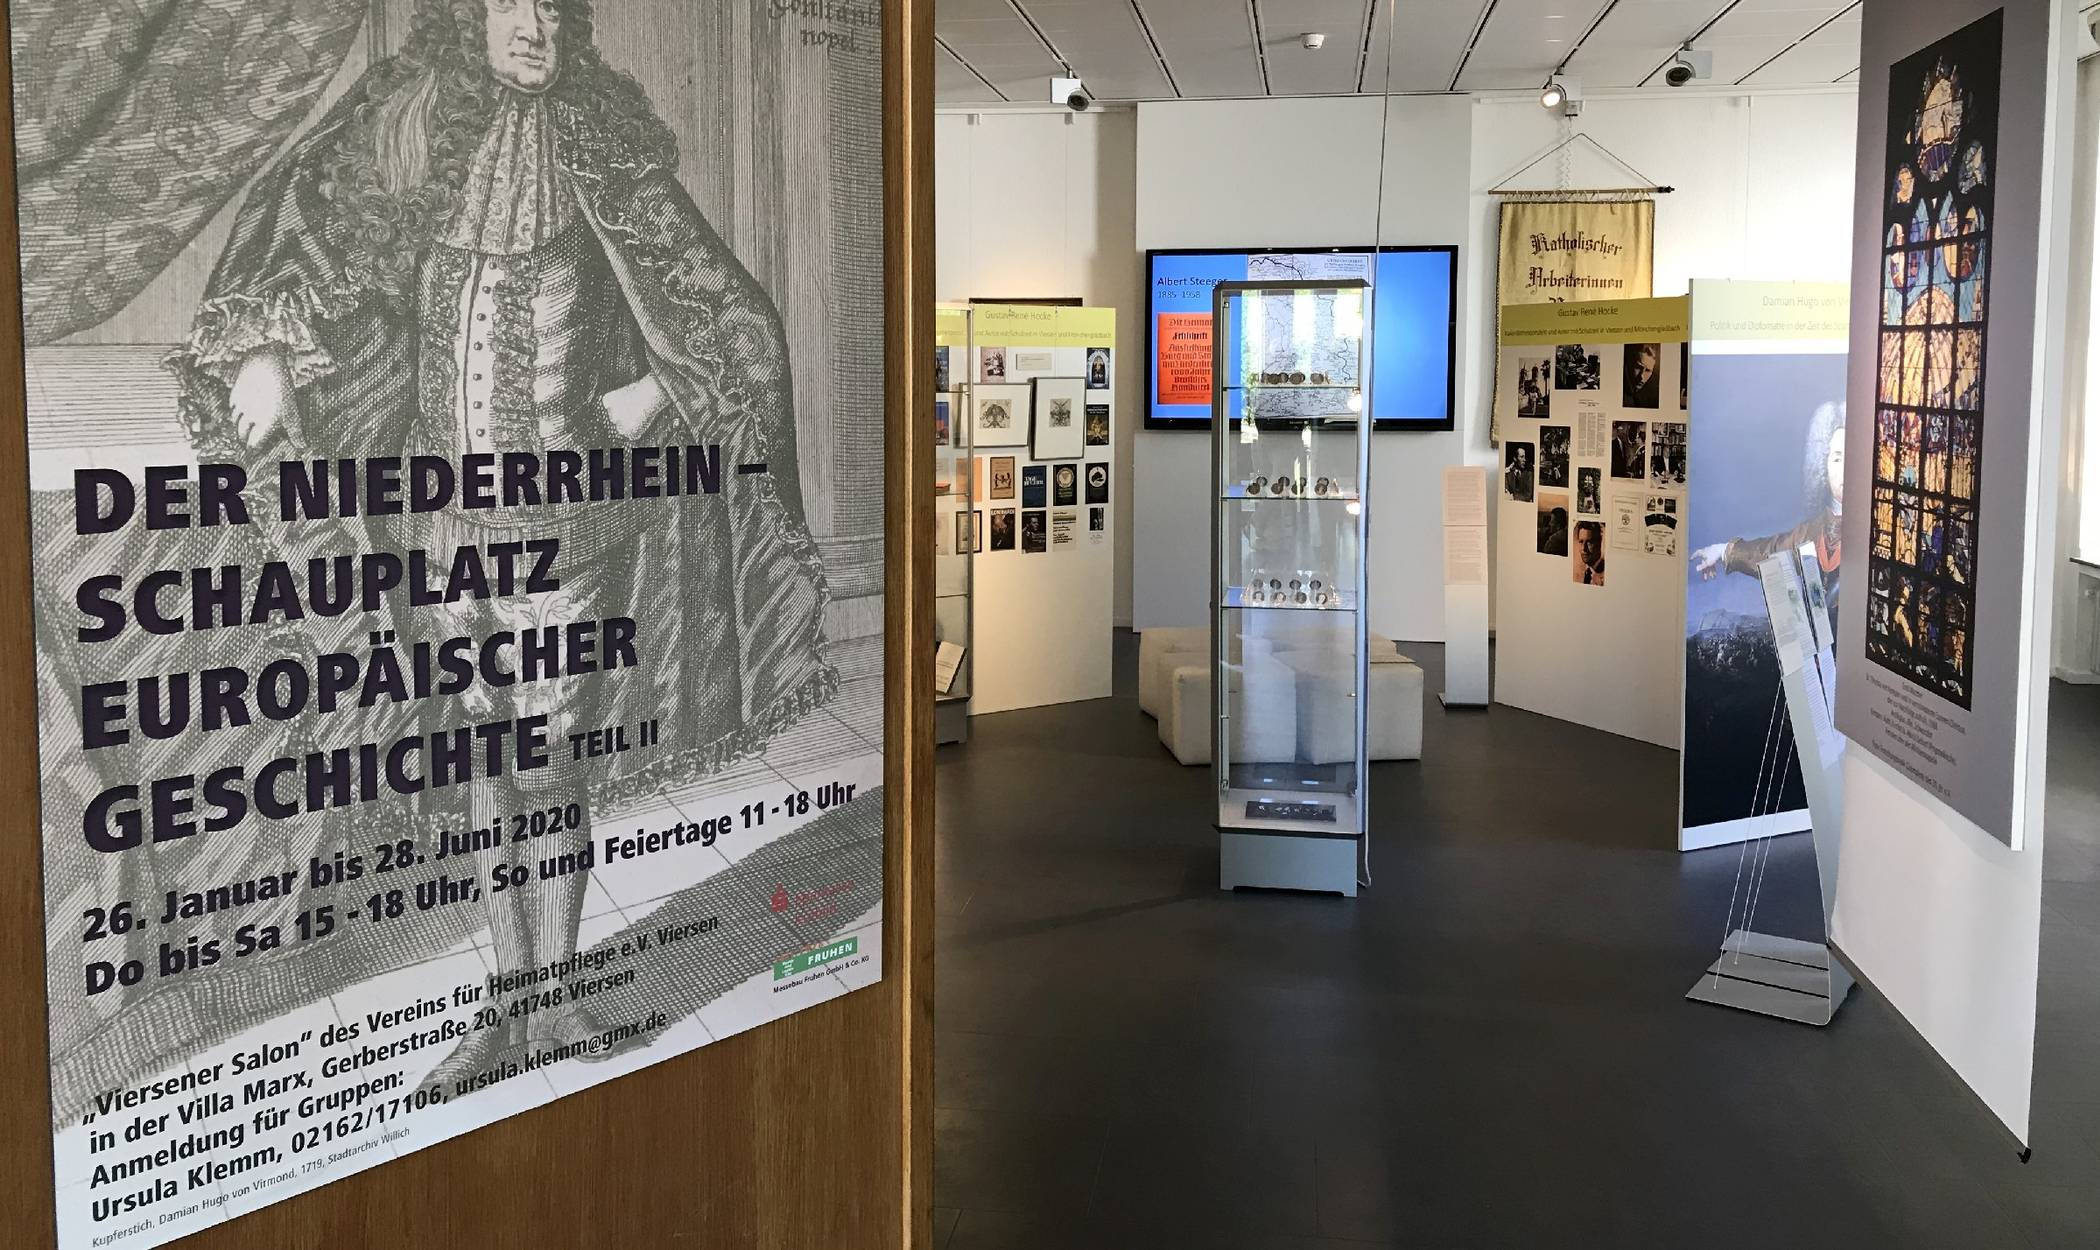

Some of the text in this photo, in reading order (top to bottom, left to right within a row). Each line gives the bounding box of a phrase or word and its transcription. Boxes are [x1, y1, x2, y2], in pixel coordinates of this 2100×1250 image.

[1157, 277, 1187, 287] Albert
[1525, 266, 1623, 295] Arbeiterinnen
[1530, 231, 1622, 256] Katholischer
[74, 463, 249, 535] DER
[280, 445, 720, 521] NIEDERRHEIN
[76, 538, 560, 643] SCHAUPLATZ
[82, 617, 638, 750] EUROPÄISCHER
[83, 715, 658, 853] GESCHICHTE TEIL II
[83, 803, 581, 942] 26. Januar bis 28. Juni 2020
[85, 958, 144, 996] Do
[160, 936, 221, 977] bis
[235, 921, 281, 958] Sa
[295, 904, 335, 940] 15
[366, 889, 405, 924] 18
[416, 874, 480, 912] Uhr,
[491, 864, 528, 893] So
[539, 841, 595, 881] und
[605, 812, 732, 865] Feiertage
[740, 802, 763, 829] 11
[784, 790, 810, 817] 18
[817, 780, 857, 811] Uhr
[320, 1020, 360, 1049] des
[367, 993, 446, 1034] Vereins
[452, 982, 483, 1009] für
[487, 949, 617, 998] Heimatpflege
[620, 934, 653, 957] e.V.
[658, 914, 719, 945] Viersen
[773, 978, 803, 993] Messebau
[826, 964, 844, 975] GmbH
[807, 942, 853, 966] FRUHEN
[90, 968, 635, 1154] in der Villa Marx, Gerberstraße 20, 41748 Viersen
[91, 1011, 667, 1223] Ursula Klemm, 02162/17106, ursula.klemm@gmx.de
[90, 1071, 404, 1189] Anmeldung für Gruppen:
[91, 1126, 410, 1248] Kupferstich, Damian Hugo von Virmond, 1719, Stadtarchiv Willich
